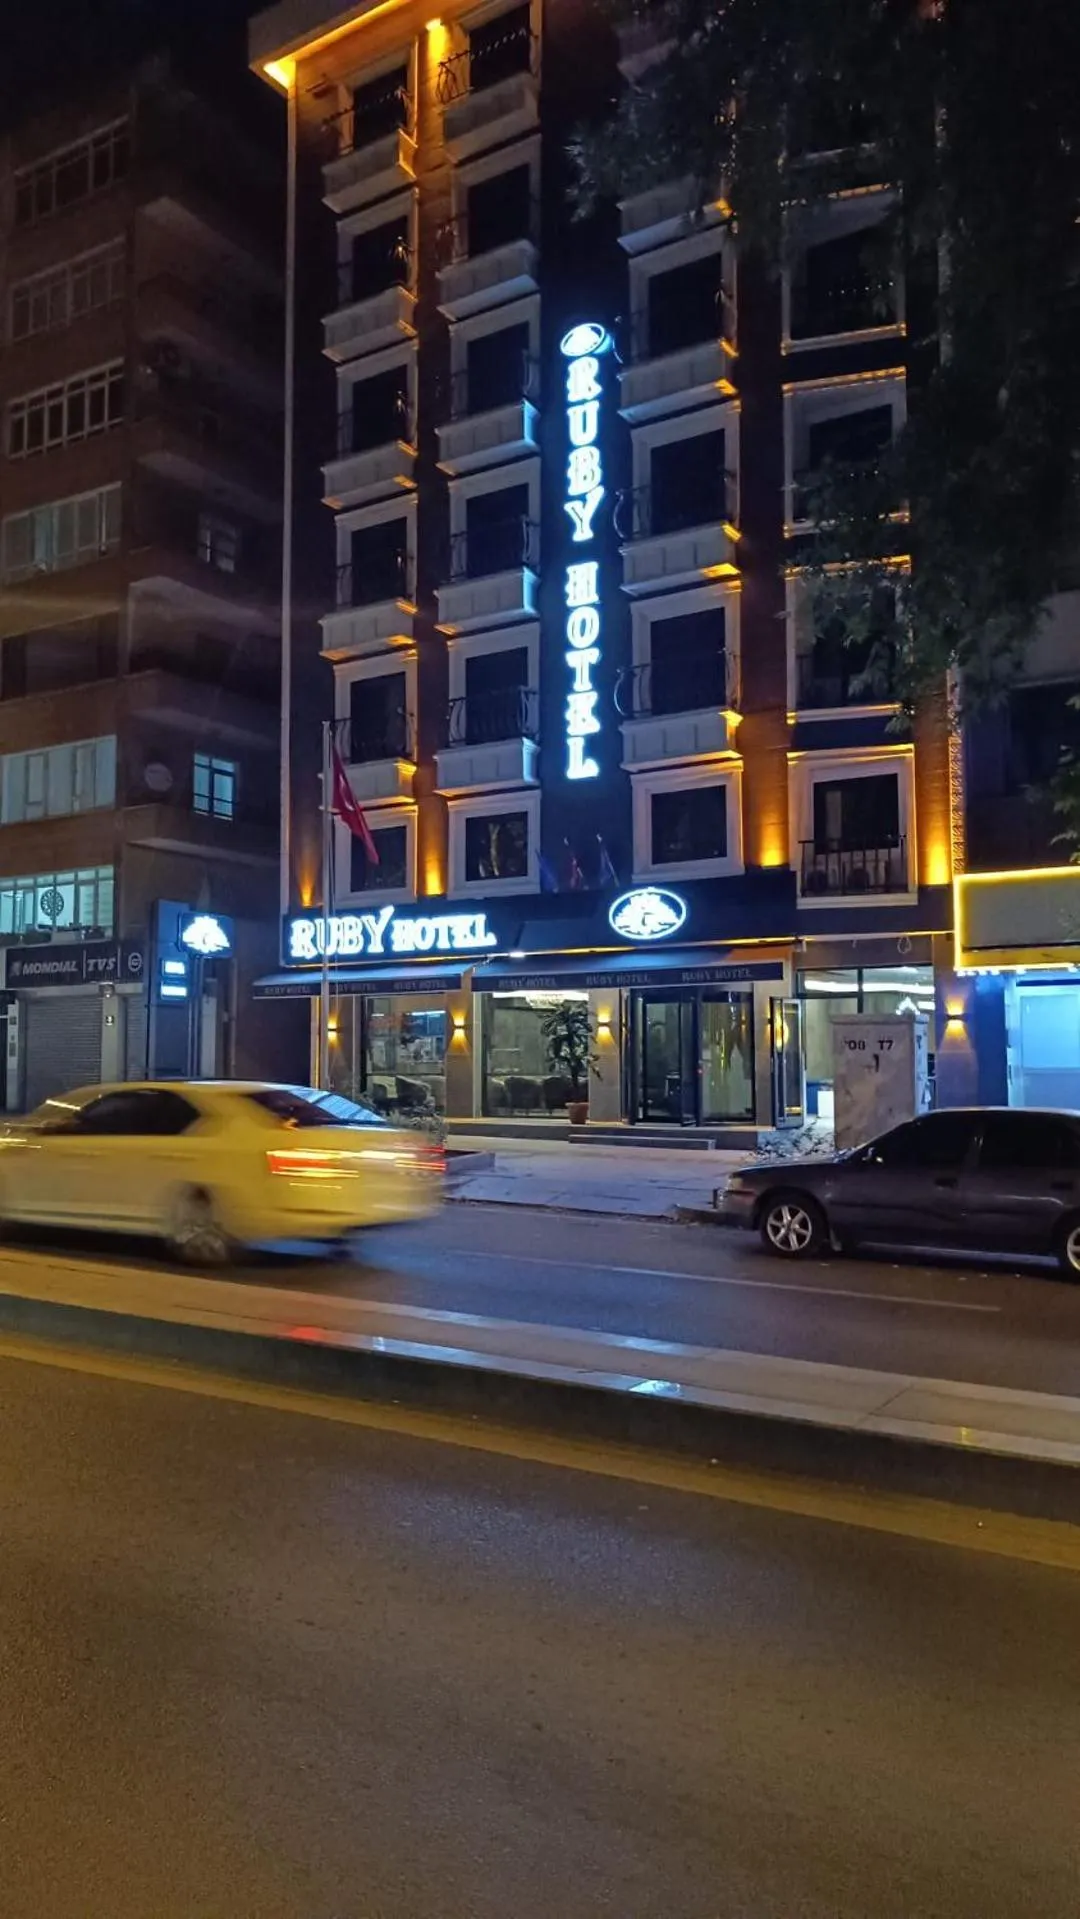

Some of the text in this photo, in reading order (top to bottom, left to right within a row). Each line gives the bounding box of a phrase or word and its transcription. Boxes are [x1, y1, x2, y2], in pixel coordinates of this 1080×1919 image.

[564, 357, 604, 779] RUBY HOTEL
[290, 905, 497, 959] RUBY HOTEL
[22, 958, 116, 977] MONDIAL TVS
